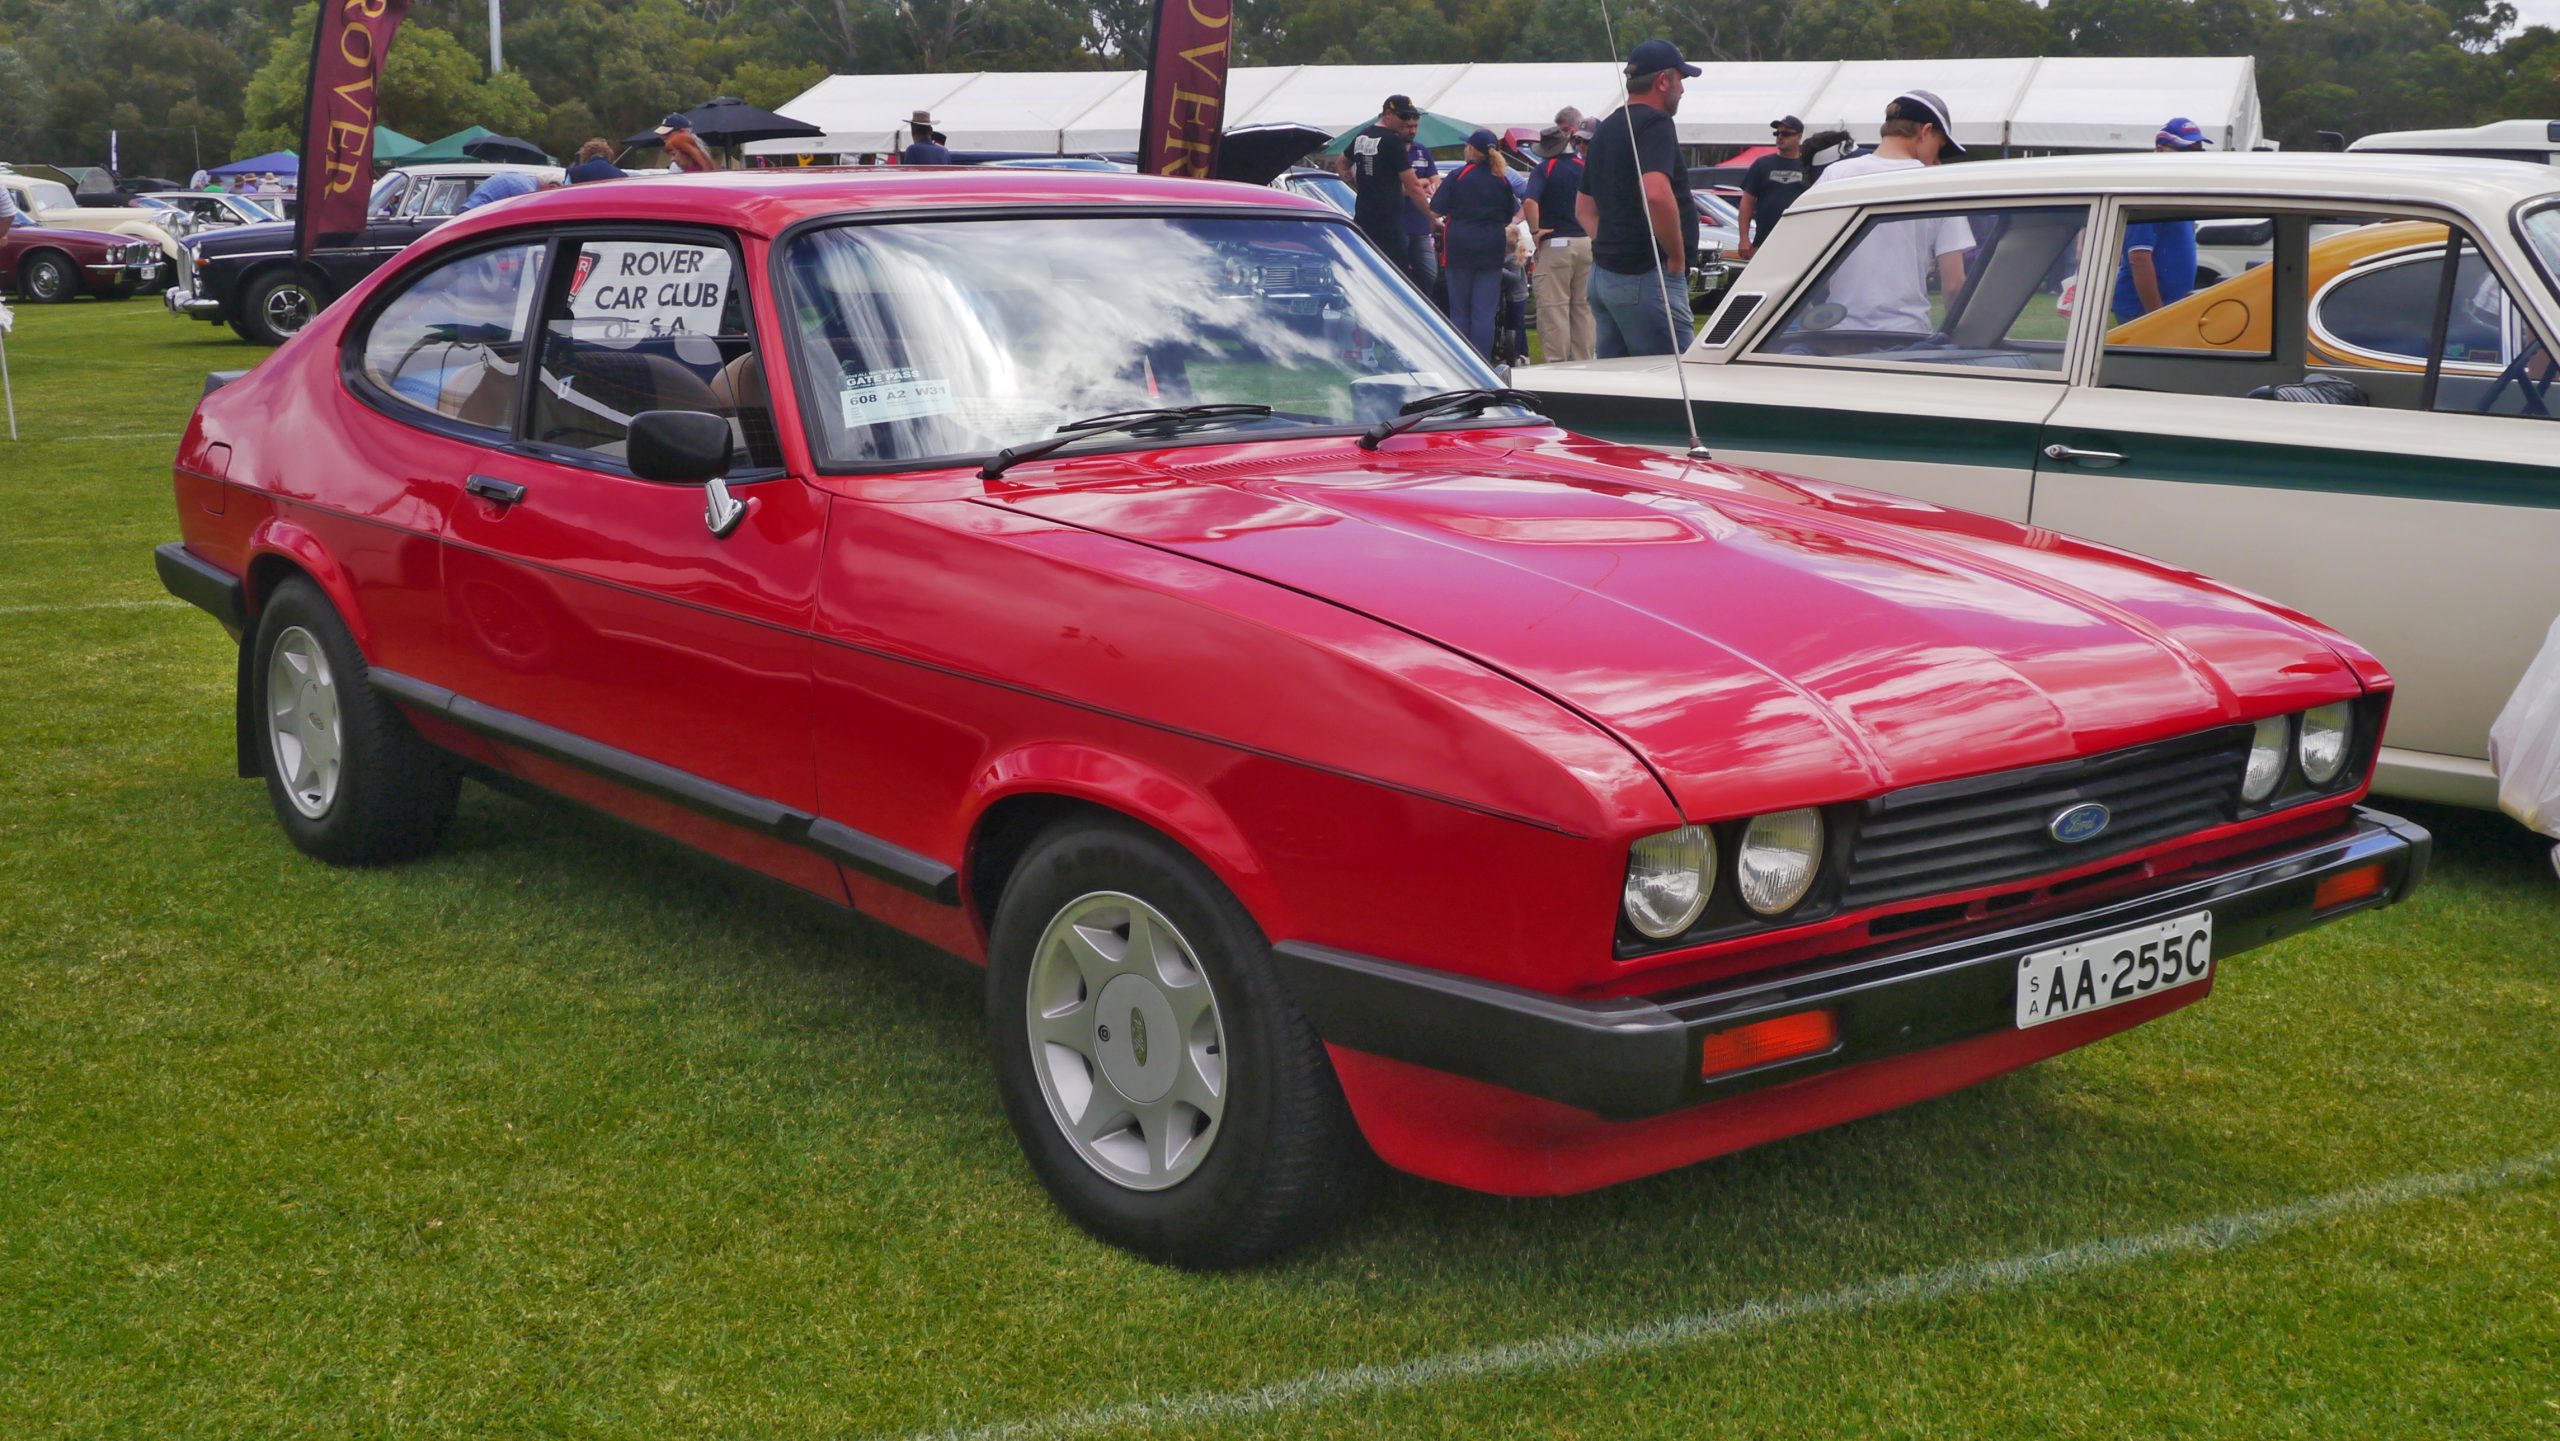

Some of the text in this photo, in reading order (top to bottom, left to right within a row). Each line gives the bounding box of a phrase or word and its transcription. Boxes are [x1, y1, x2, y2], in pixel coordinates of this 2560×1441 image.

[620, 250, 704, 276] ROVER
[595, 283, 719, 309] CAR CLUB
[846, 374, 882, 386] GATE
[886, 370, 920, 381] PASS
[850, 394, 878, 406] 608
[886, 390, 906, 401] A2
